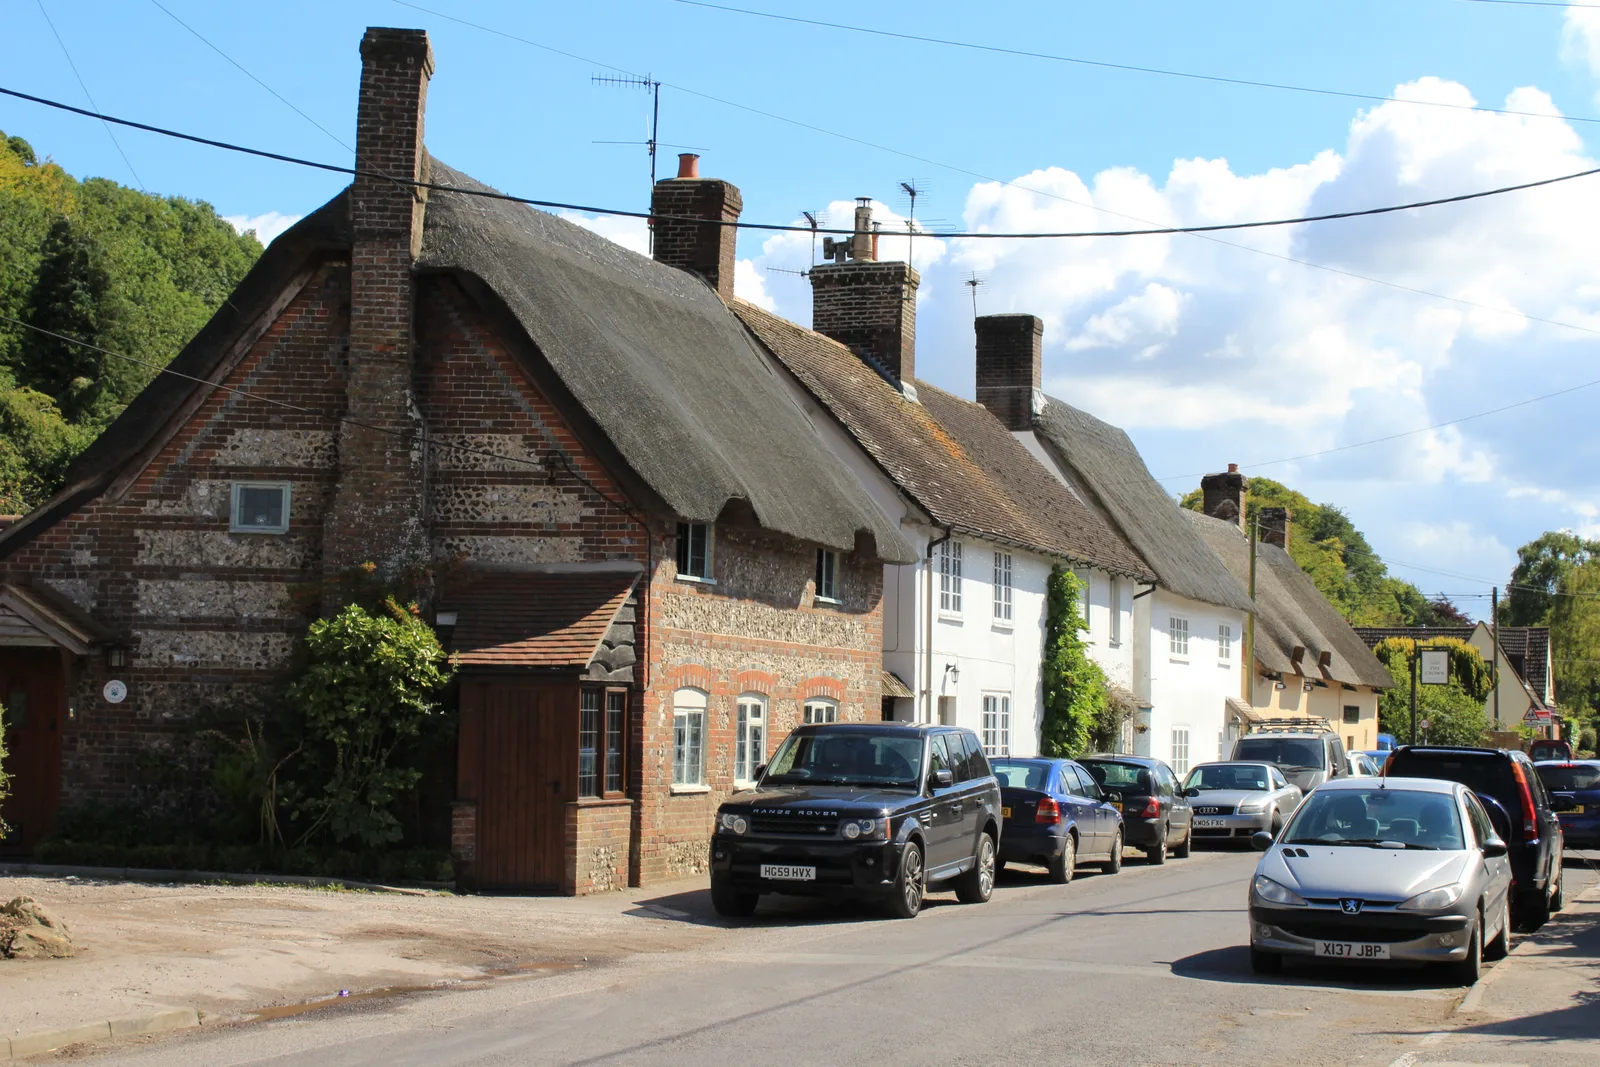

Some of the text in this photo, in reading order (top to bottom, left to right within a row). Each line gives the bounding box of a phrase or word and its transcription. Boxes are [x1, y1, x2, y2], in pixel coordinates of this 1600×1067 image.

[764, 866, 812, 878] HG59 HVX
[1323, 942, 1382, 957] X137 JBP
